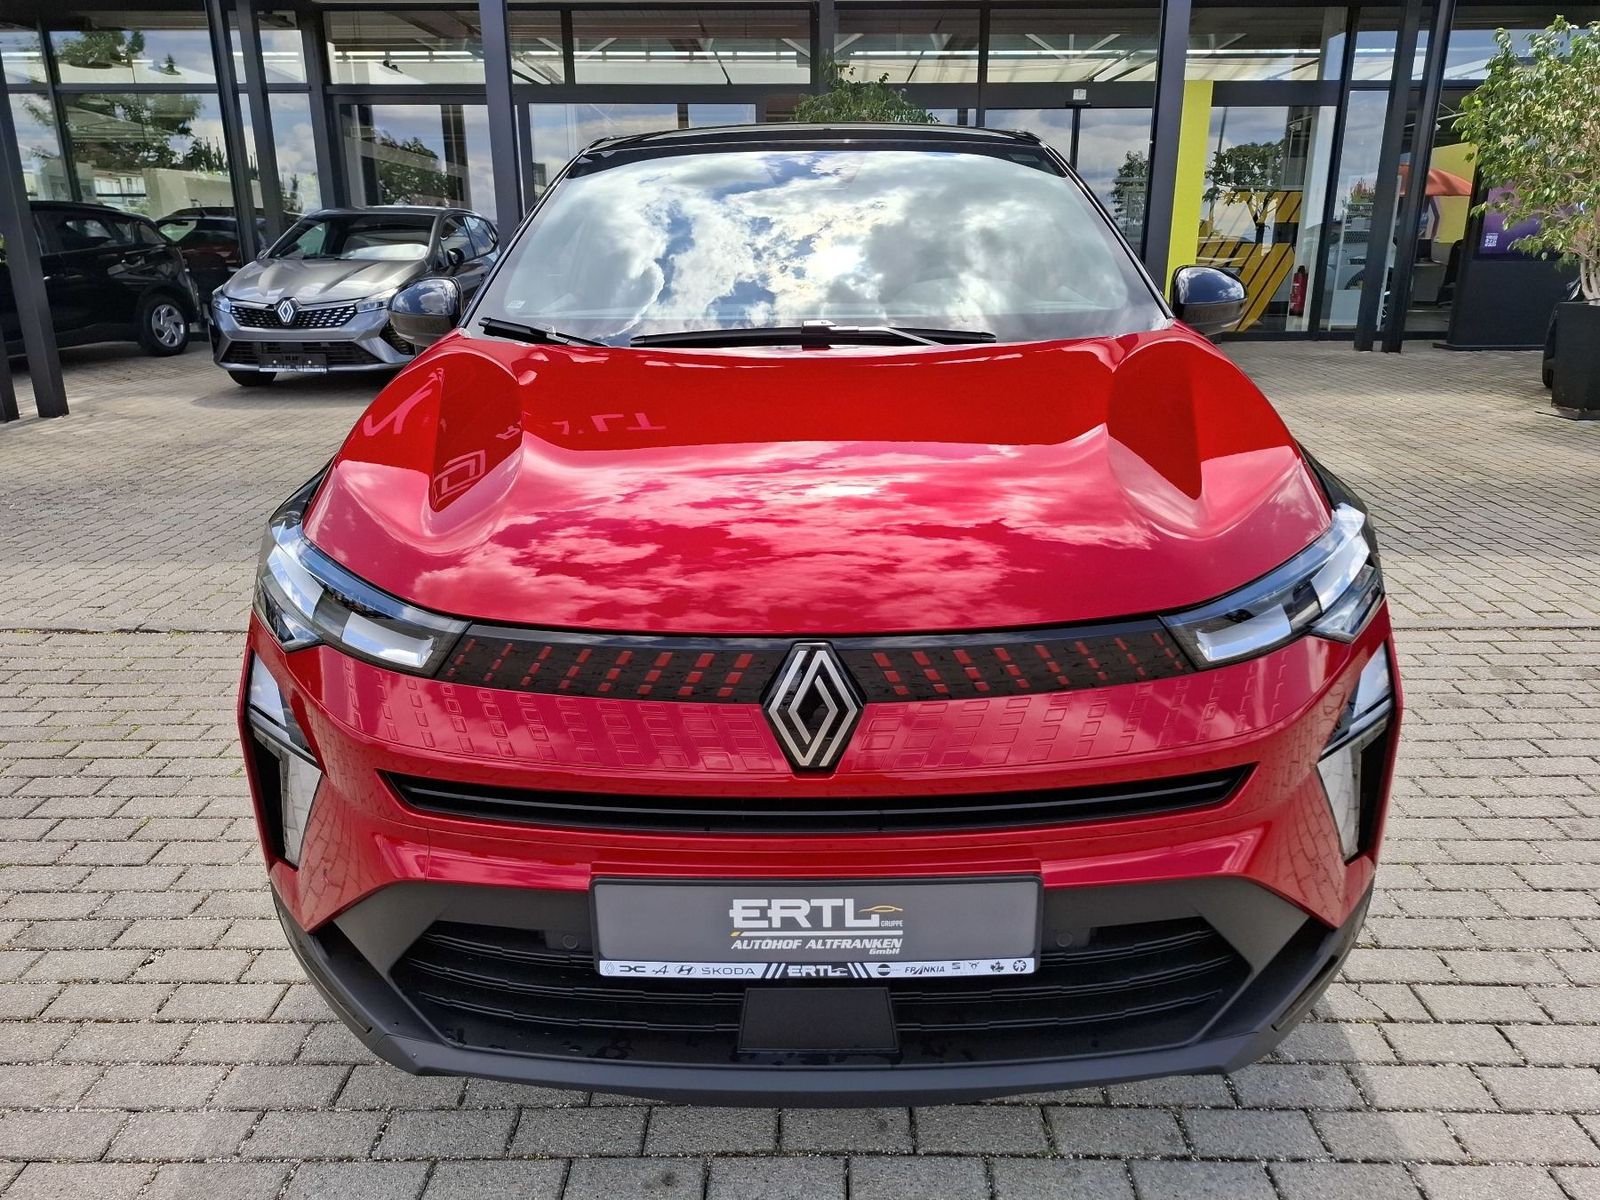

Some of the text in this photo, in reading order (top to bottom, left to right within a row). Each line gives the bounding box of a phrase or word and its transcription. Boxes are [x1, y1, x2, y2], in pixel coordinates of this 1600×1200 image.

[729, 898, 880, 928] ERTL
[880, 919, 904, 928] GRUPPE
[731, 938, 904, 950] AUTOHOF ALTFRANKEN
[869, 947, 900, 955] GmbH
[787, 965, 848, 977] ERTL
